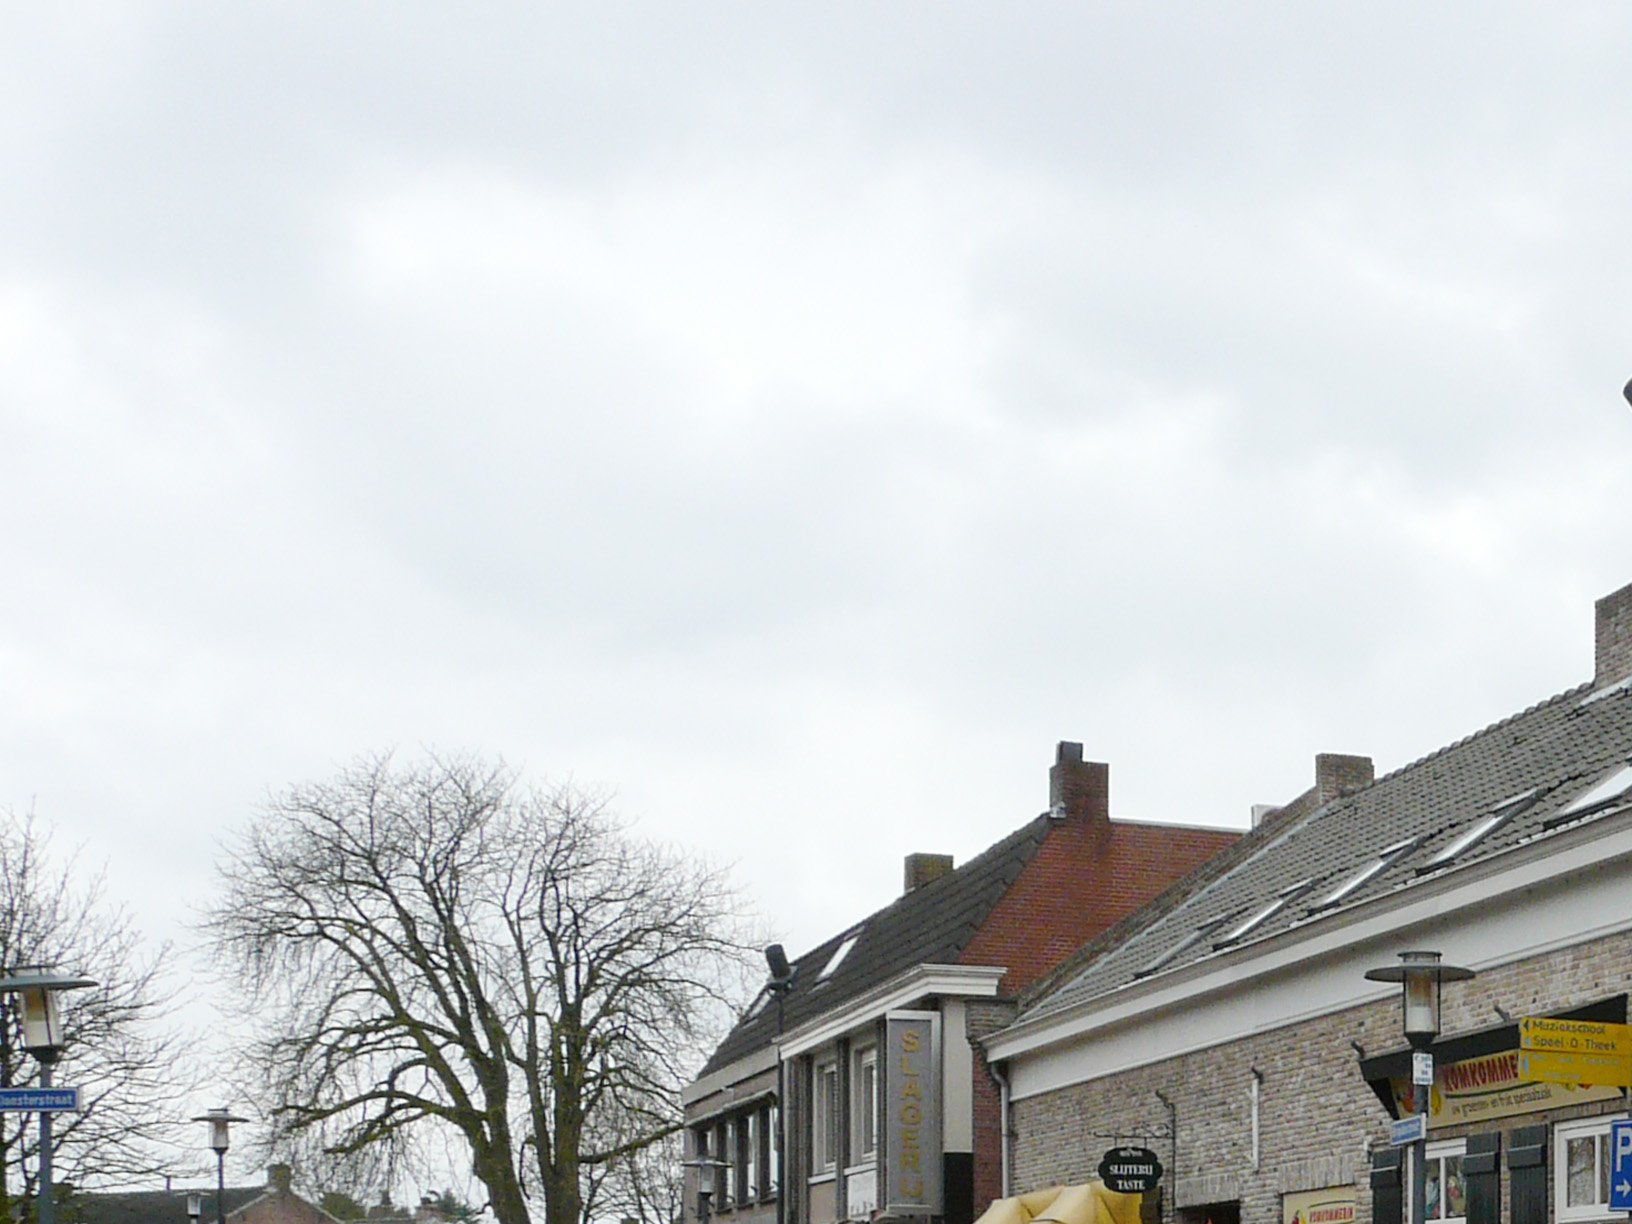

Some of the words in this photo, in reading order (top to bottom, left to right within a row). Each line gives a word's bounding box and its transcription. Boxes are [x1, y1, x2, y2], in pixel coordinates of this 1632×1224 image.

[1532, 1020, 1606, 1035] Muziekschool
[1443, 1051, 1519, 1092] KOMKOMME
[1117, 1180, 1146, 1190] TASTE
